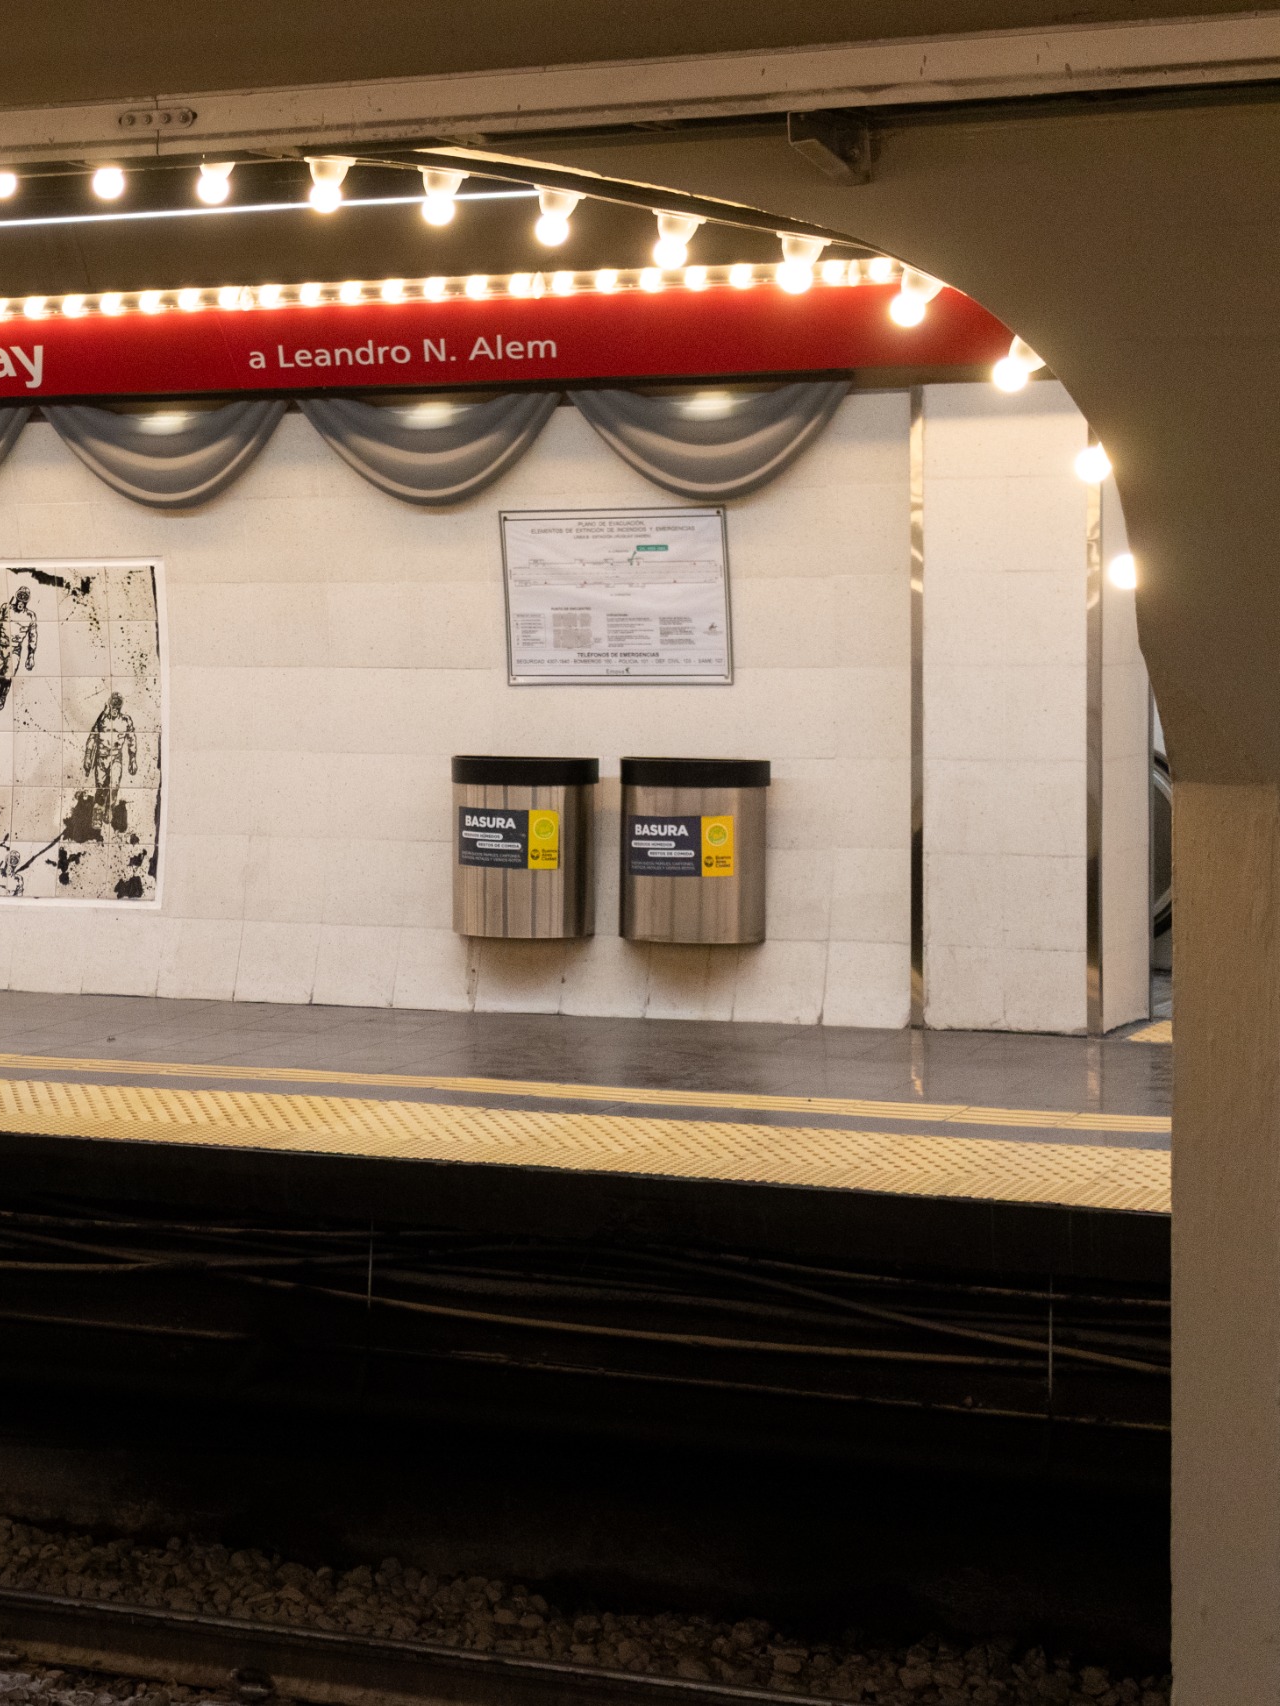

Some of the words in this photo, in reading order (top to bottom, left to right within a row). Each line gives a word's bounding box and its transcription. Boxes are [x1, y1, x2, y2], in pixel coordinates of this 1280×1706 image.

[249, 350, 266, 369] a
[277, 339, 411, 368] Leandro
[422, 338, 457, 362] N.
[469, 334, 557, 360] Alem
[465, 815, 516, 829] BASURA
[634, 823, 689, 836] BASURA
